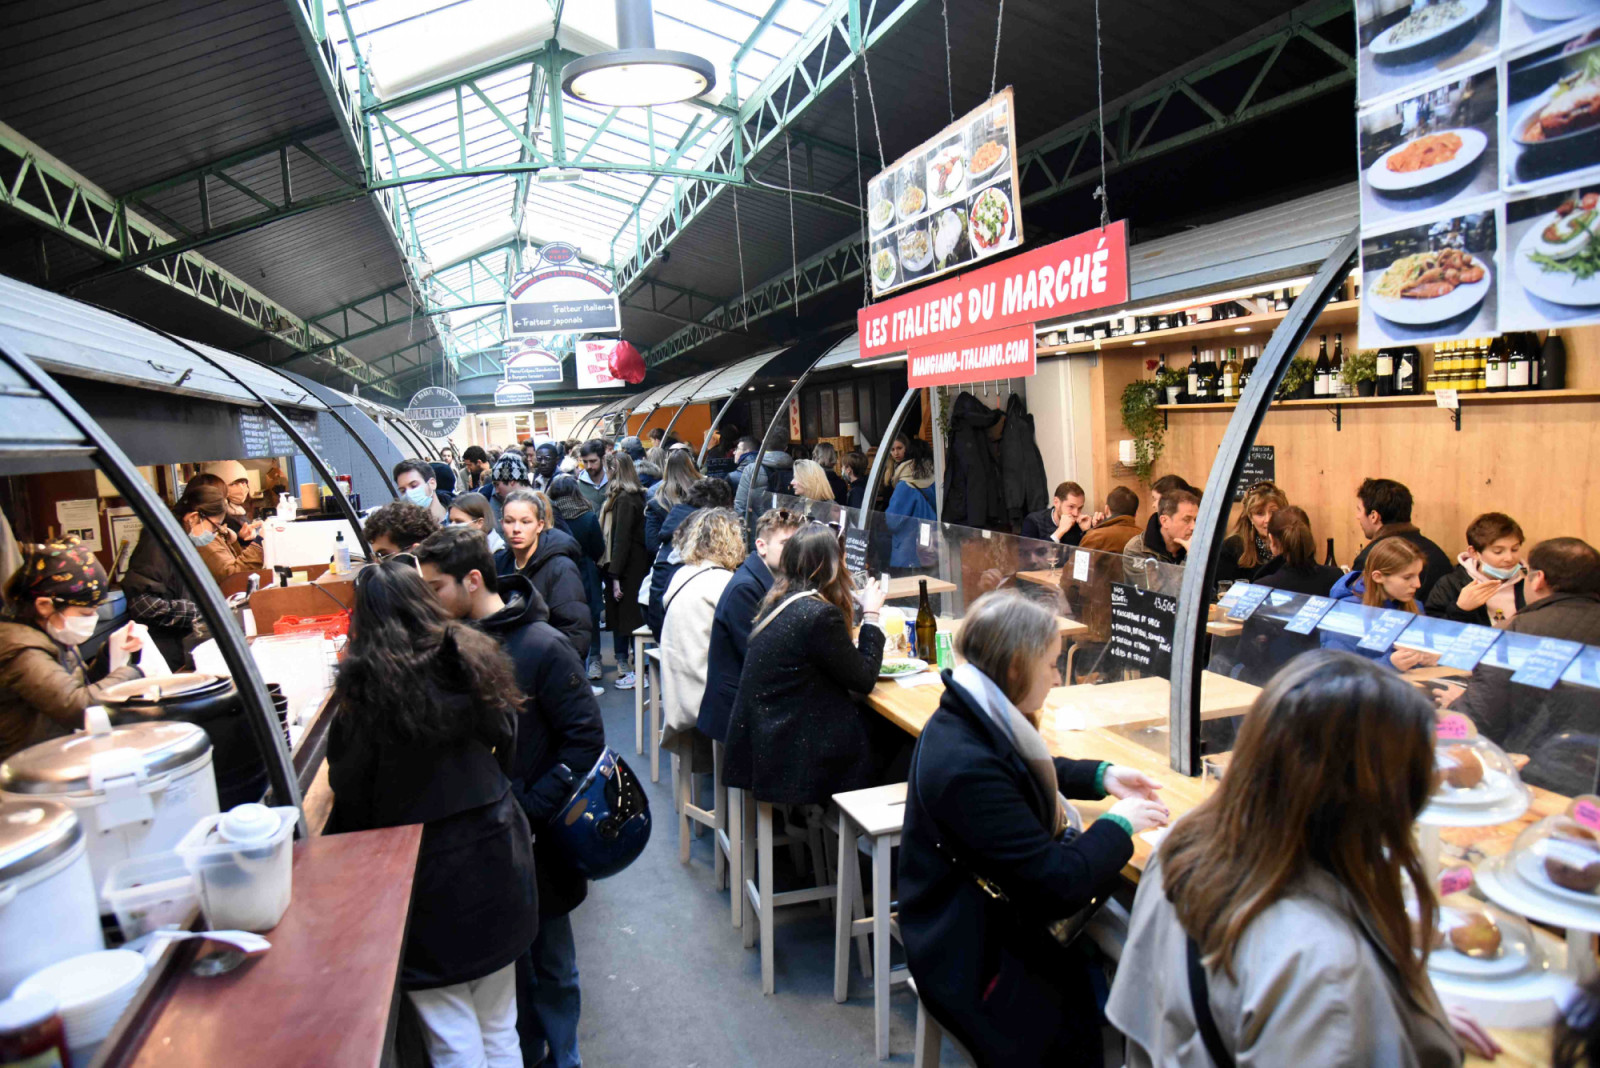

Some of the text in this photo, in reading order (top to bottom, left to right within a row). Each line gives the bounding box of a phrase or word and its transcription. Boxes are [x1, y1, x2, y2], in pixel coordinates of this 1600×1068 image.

[585, 276, 610, 292] ROUGES
[866, 237, 1109, 348] LES ITALIENS DU MARCHÉ
[552, 304, 582, 314] Traiteur
[521, 316, 583, 327] Traiteur japonais
[912, 338, 1029, 377] MANGIAMO-ITALIANO.COM
[405, 406, 465, 419] BURGER FERMIER
